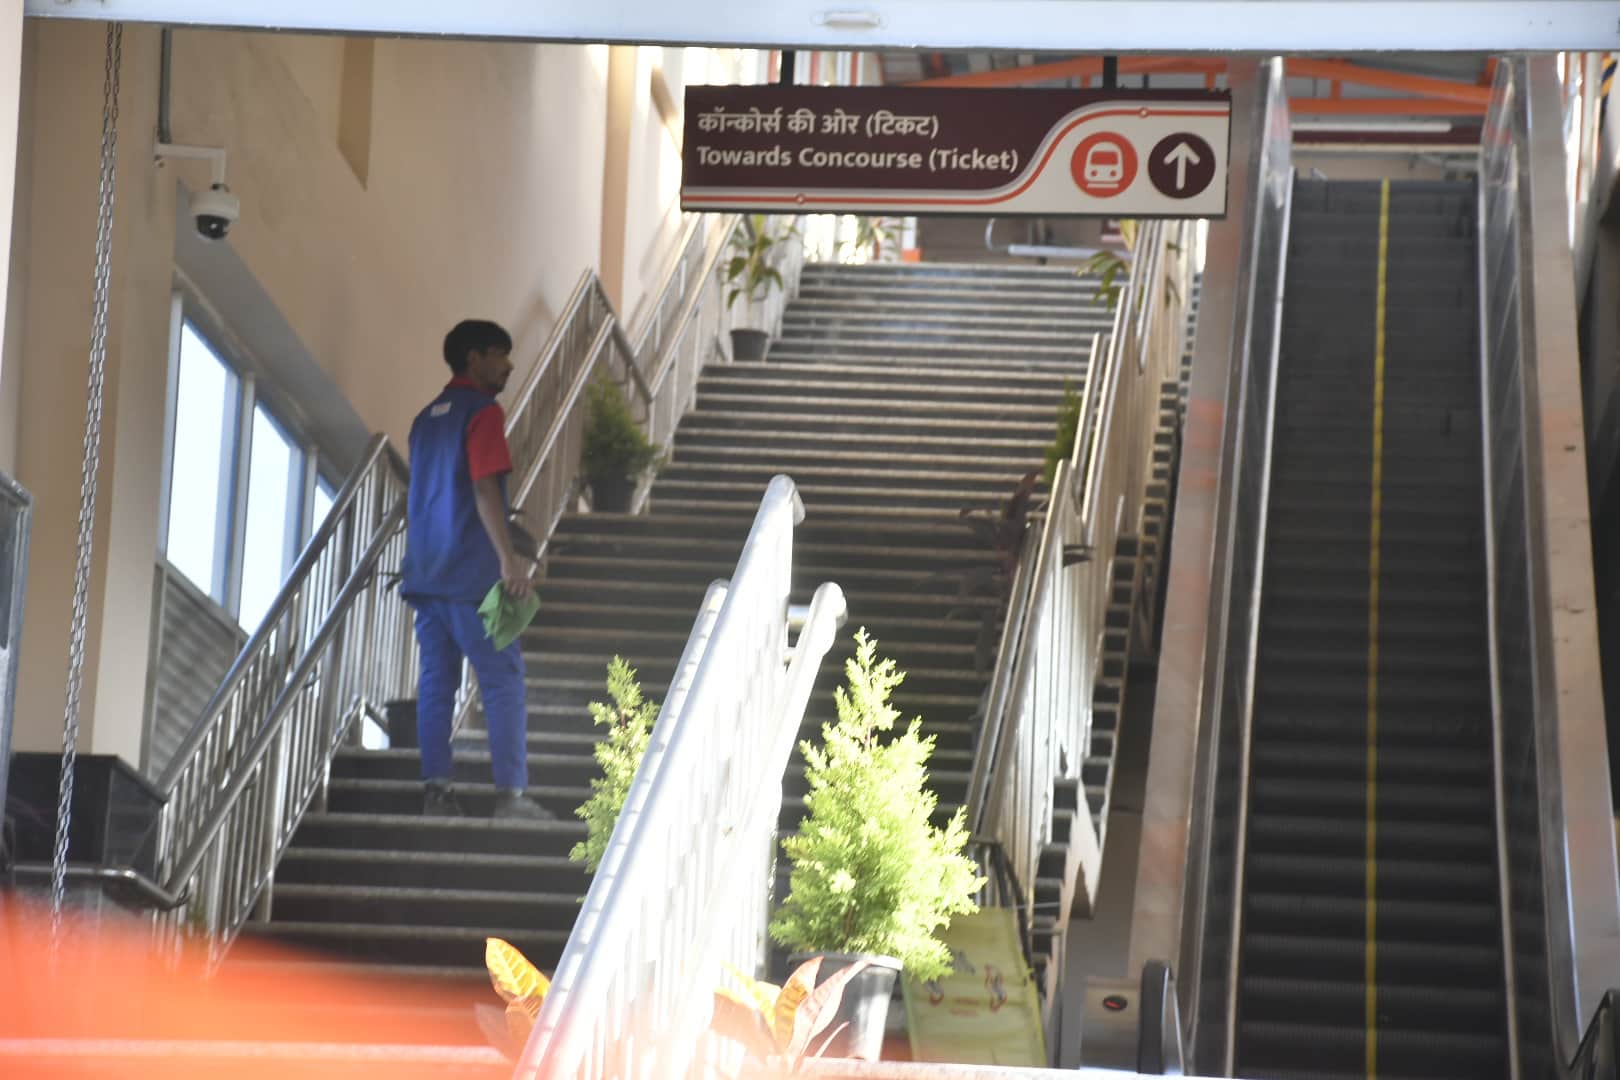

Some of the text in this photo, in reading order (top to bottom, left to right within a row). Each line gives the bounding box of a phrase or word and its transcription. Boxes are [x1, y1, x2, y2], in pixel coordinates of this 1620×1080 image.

[698, 106, 939, 138] कॉन्कोर्स की ओर (टिकट)
[697, 146, 1019, 173] Towards Concourse (Ticket)
